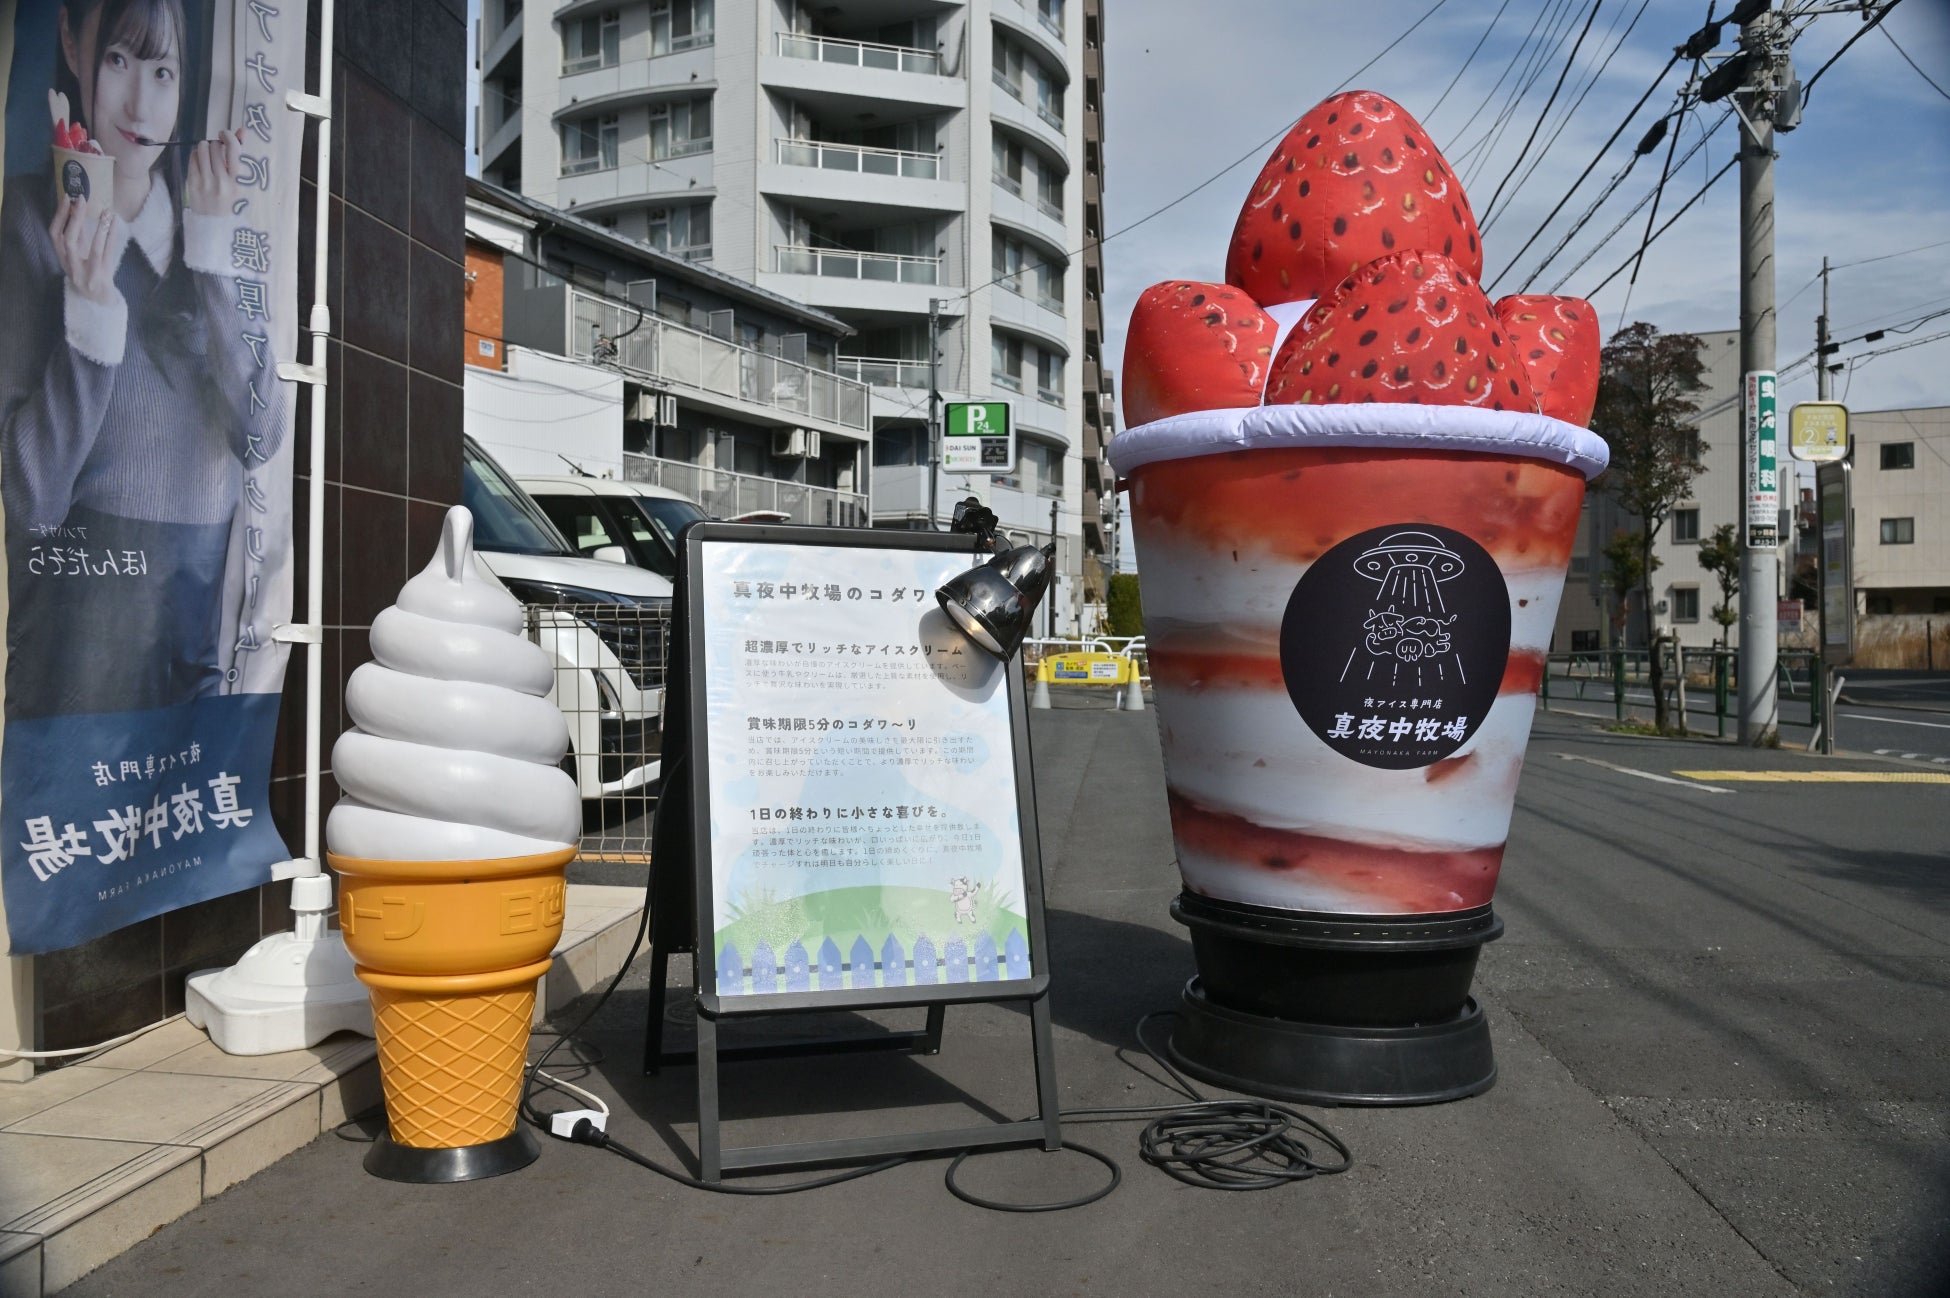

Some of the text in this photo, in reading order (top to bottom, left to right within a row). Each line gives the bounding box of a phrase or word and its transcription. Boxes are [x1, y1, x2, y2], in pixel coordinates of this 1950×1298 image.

[967, 405, 986, 433] P
[977, 421, 989, 430] 24
[733, 581, 936, 602] 真夜中牧場のコダワ
[745, 639, 963, 656] 超濃厚でリッチなアイスクリーム
[1363, 697, 1442, 709] 夜アイス専門店
[1327, 712, 1467, 742] 真夜中牧場
[750, 804, 947, 820] 1日の終わりに小さな喜びを。
